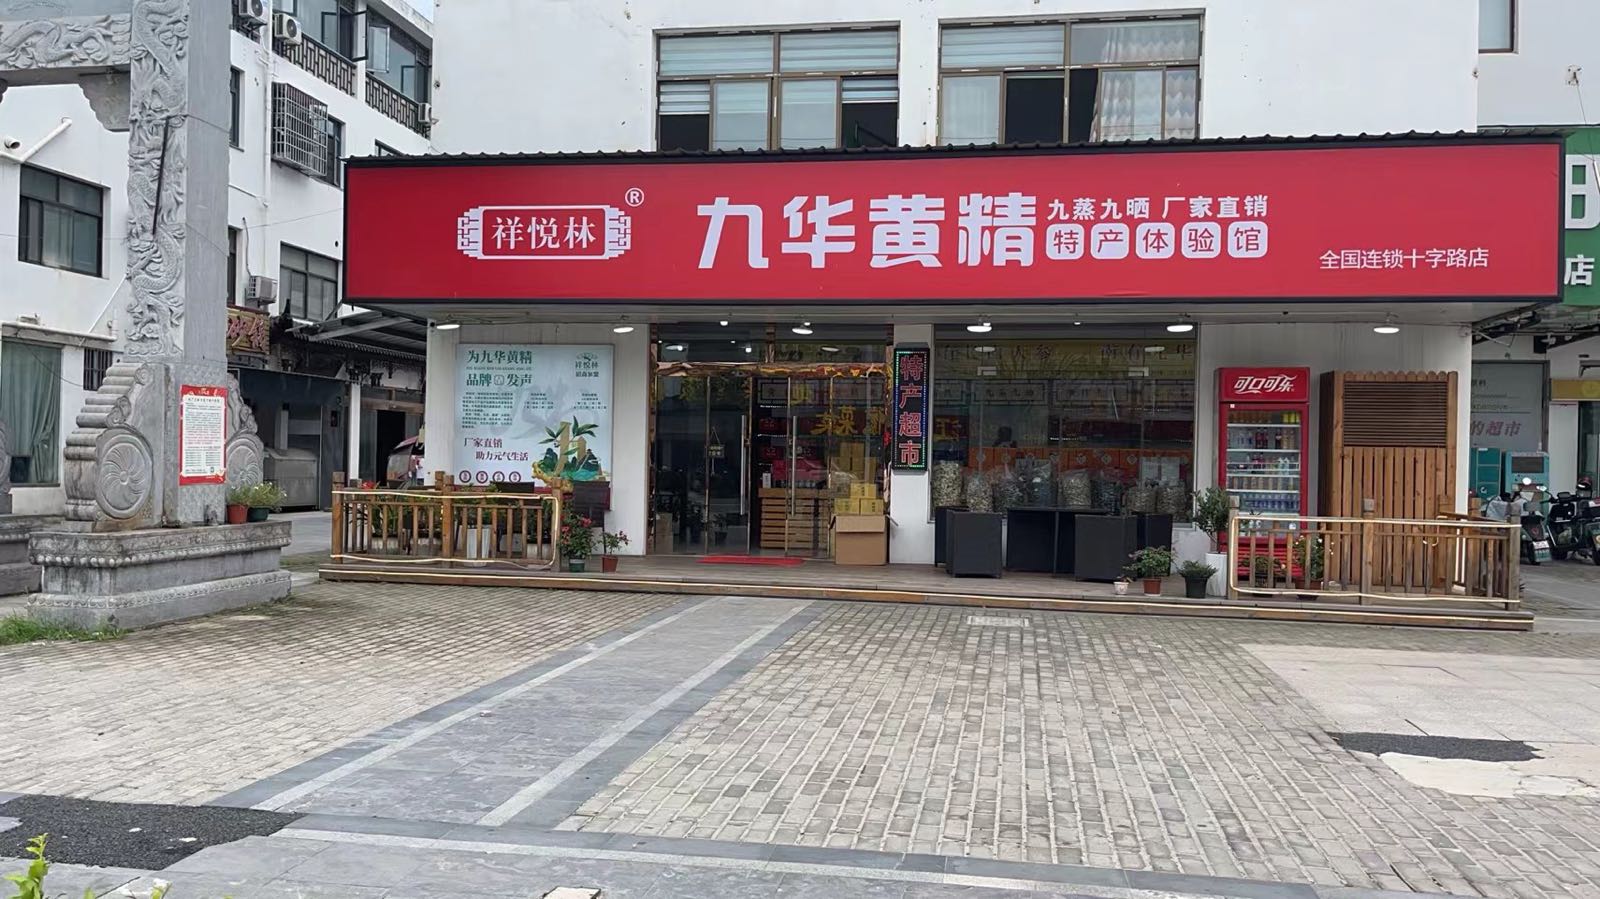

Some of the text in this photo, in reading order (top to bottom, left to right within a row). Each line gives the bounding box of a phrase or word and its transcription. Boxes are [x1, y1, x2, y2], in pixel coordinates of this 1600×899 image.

[1047, 194, 1269, 221] 九蒸九晒 厂家直销
[491, 215, 597, 250] 祥悦林
[697, 192, 1037, 269] 九华黄精
[1051, 226, 1263, 256] 特产体验馆
[1319, 247, 1489, 270] 全国连锁十字路店
[467, 350, 533, 365] 为九华黄精
[466, 373, 533, 388] 品牌 发声
[1233, 374, 1297, 394] 可口可乐
[898, 354, 924, 466] 特产超市
[464, 437, 503, 448] 厂家直销
[475, 451, 529, 461] 助力元气生活
